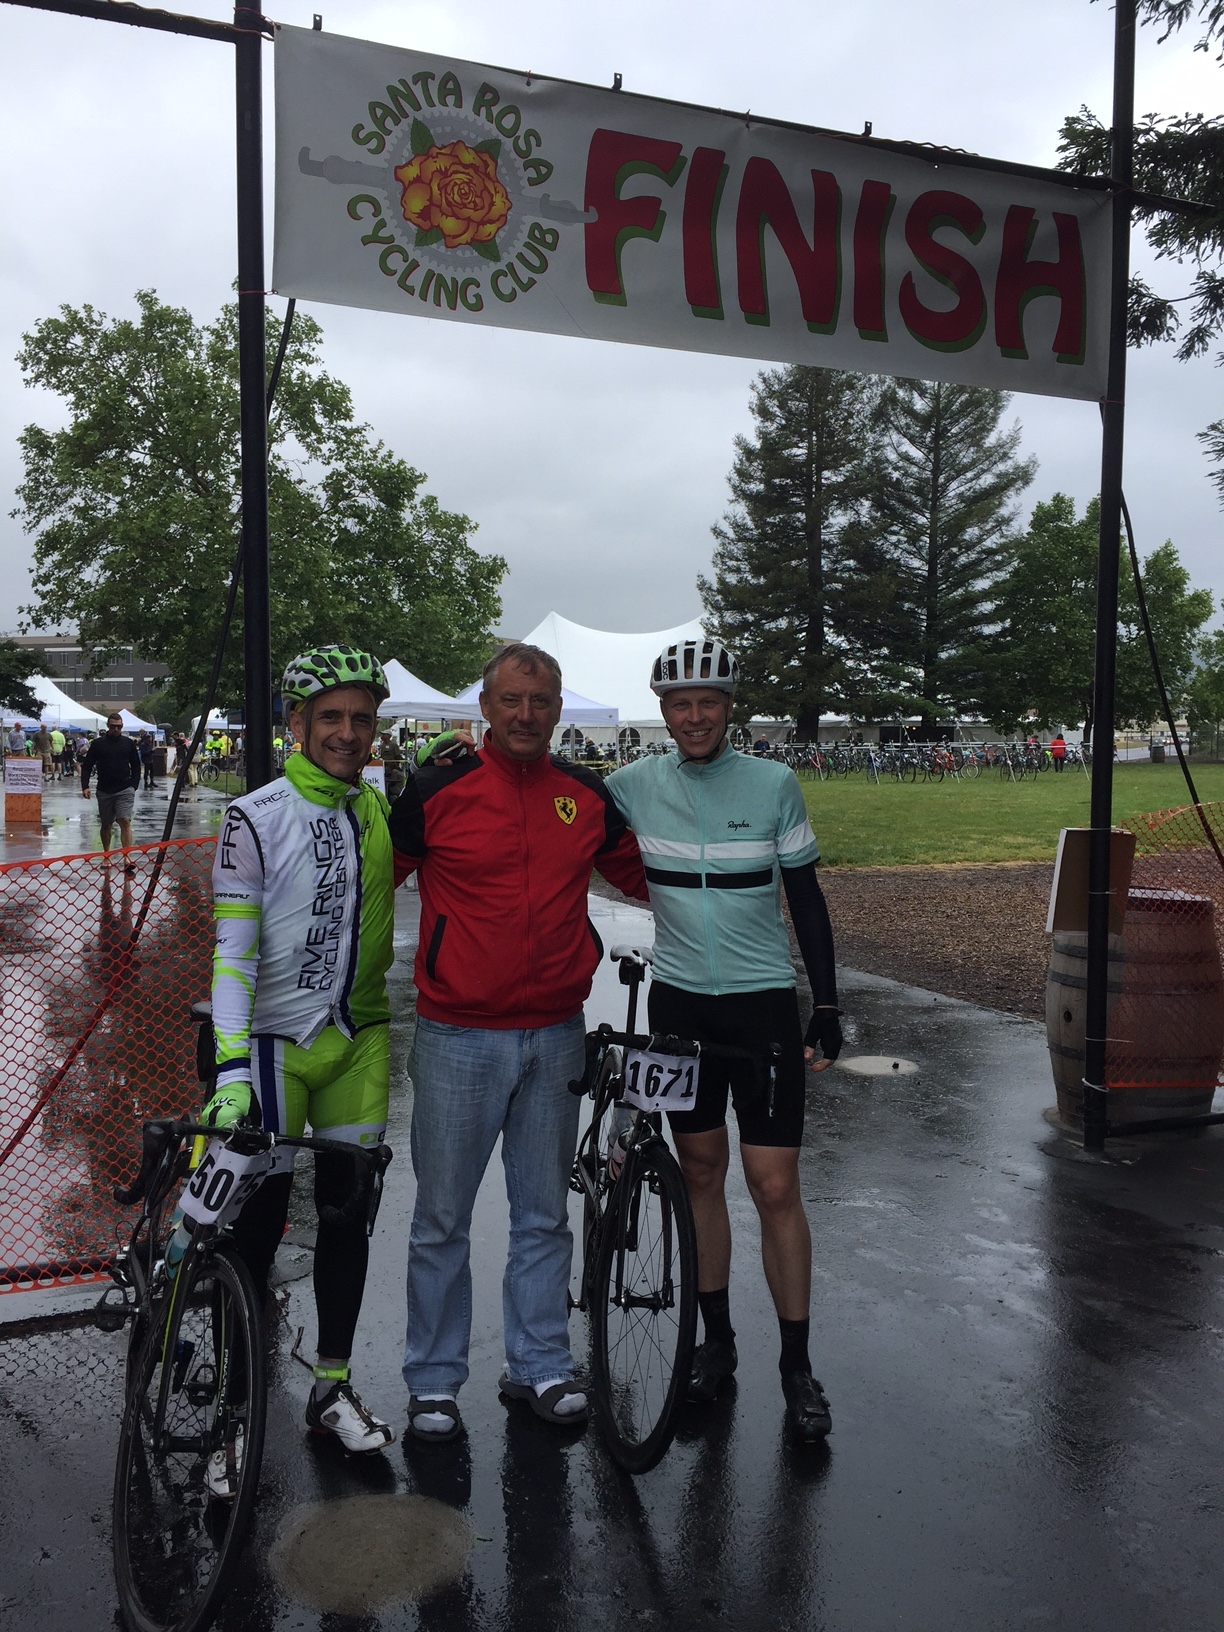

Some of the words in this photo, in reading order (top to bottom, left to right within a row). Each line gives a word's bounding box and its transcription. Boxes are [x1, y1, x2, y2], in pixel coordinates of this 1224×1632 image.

[351, 71, 463, 155] SANTA
[472, 82, 553, 187] ROSA
[347, 193, 484, 312] CYCLING
[490, 222, 560, 303] CLUB
[584, 128, 1086, 365] FINISH
[253, 789, 291, 809] FRCC
[309, 818, 335, 917] RINGS
[329, 817, 347, 898] CENTER
[297, 927, 327, 990] FIVE
[319, 905, 344, 991] CYCLING
[627, 1060, 698, 1098] 1671
